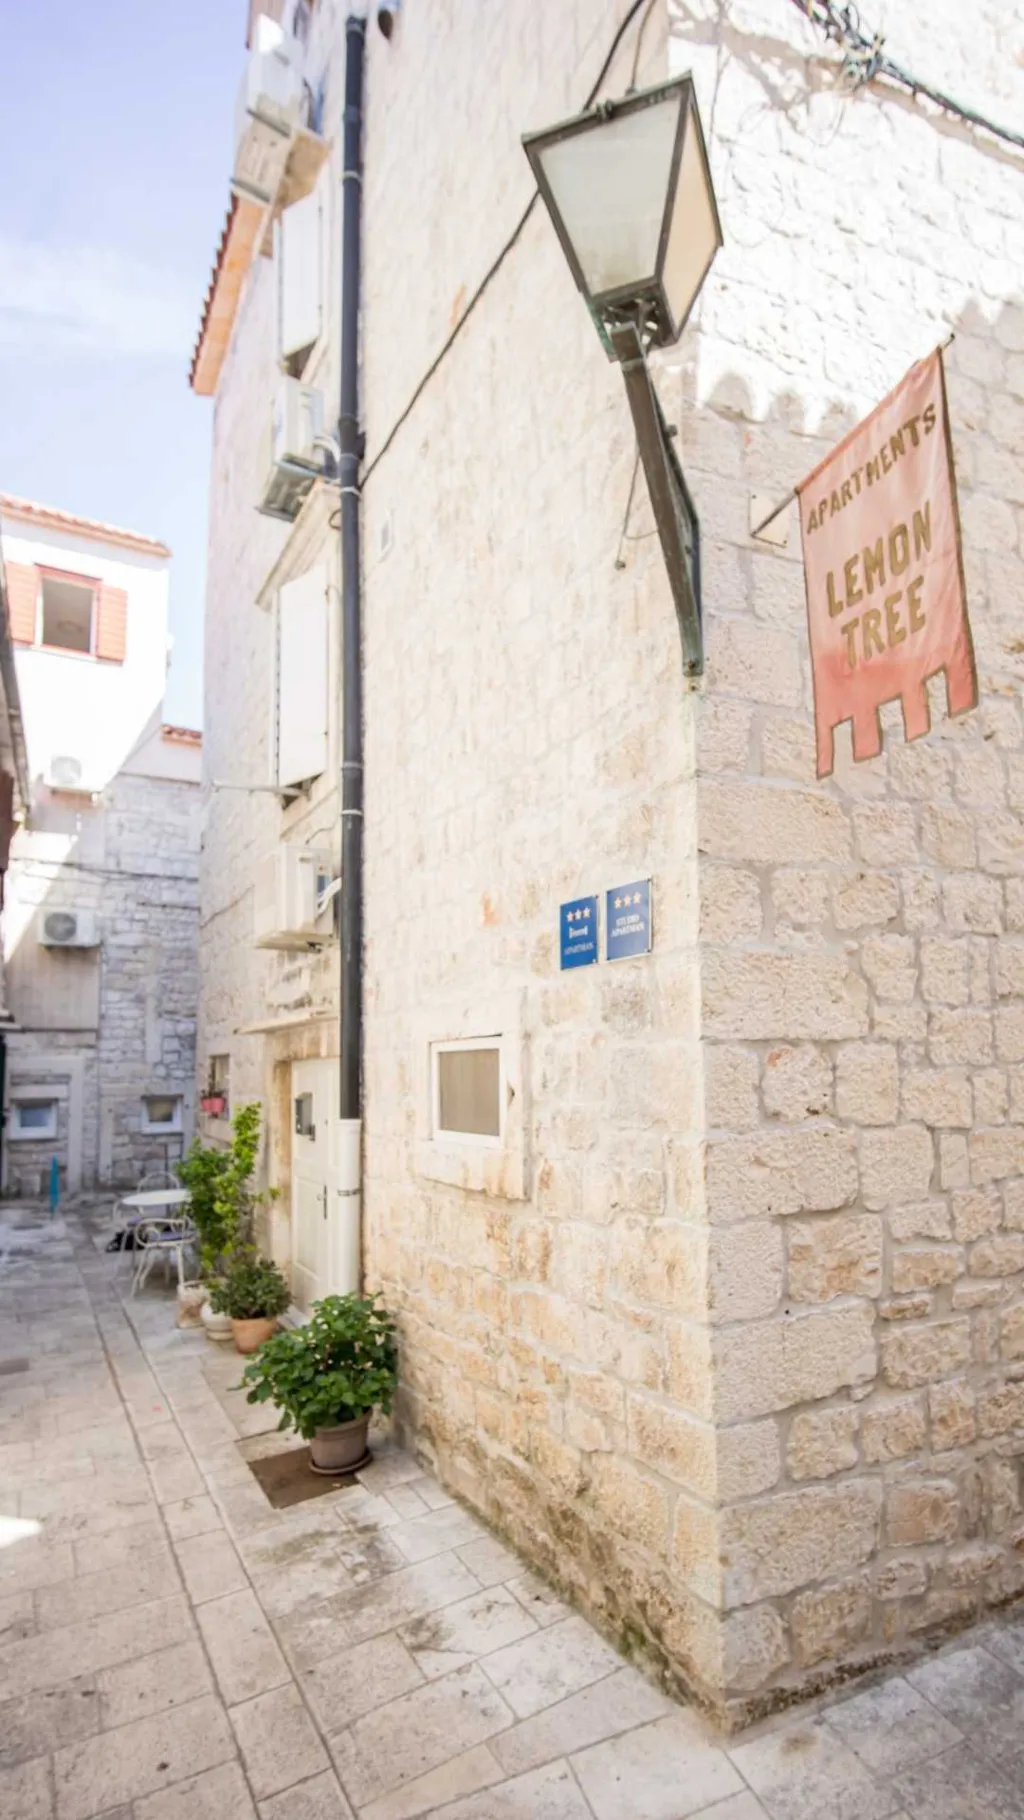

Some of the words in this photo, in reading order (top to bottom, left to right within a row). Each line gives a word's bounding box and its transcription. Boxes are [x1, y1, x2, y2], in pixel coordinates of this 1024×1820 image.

[806, 403, 936, 534] APARTMENTS
[826, 499, 931, 618] LEMON
[841, 575, 926, 669] TREE
